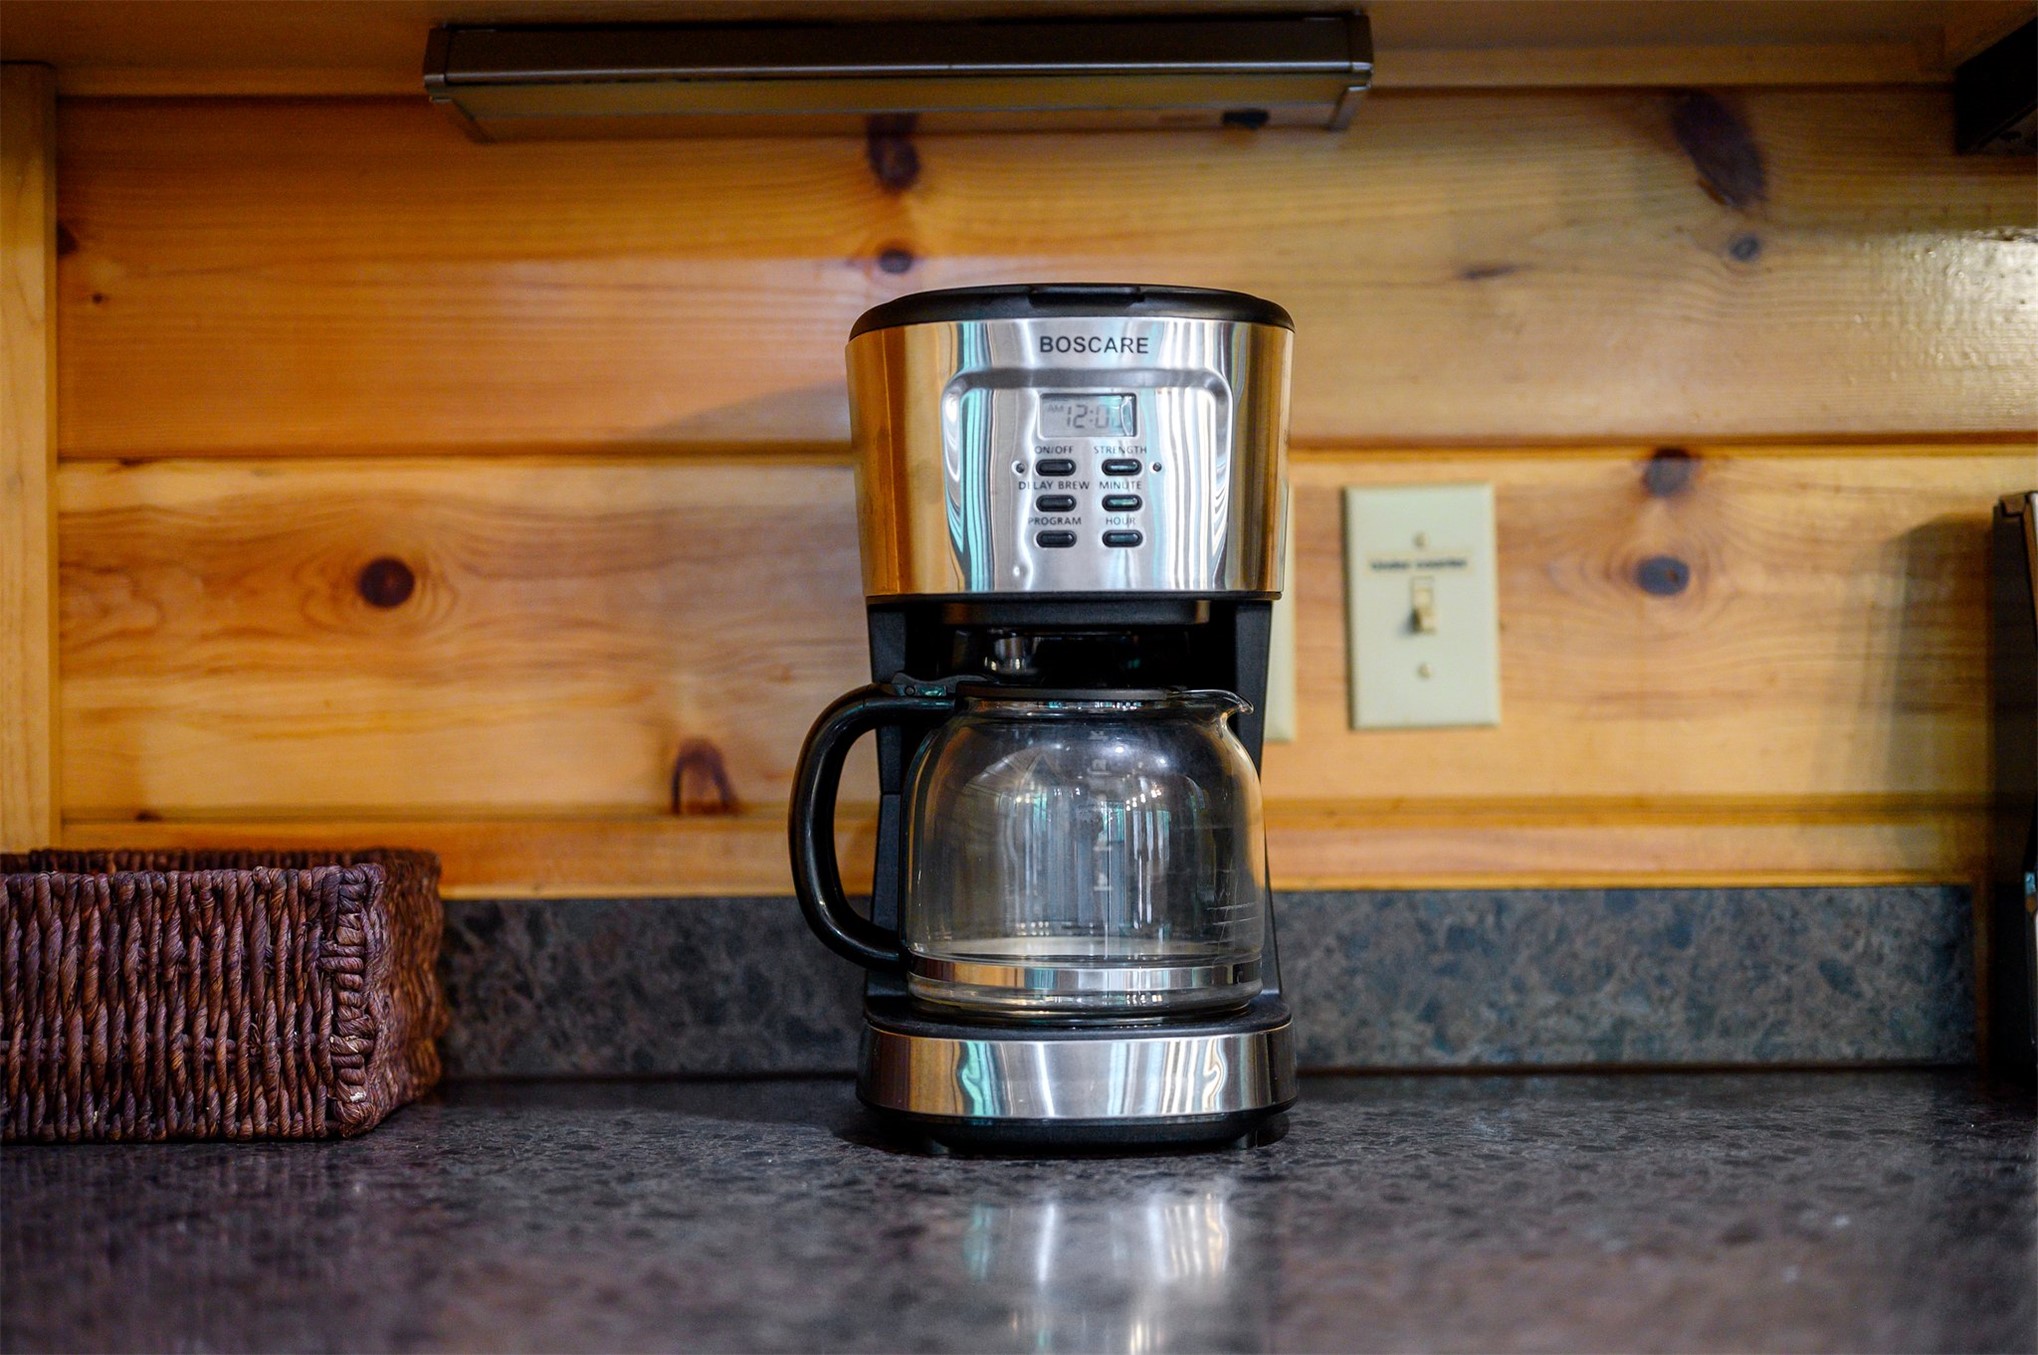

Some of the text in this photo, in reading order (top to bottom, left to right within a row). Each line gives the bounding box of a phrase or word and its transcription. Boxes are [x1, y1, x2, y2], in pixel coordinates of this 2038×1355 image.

[1040, 336, 1149, 353] BOSCARE
[1034, 445, 1074, 455] ON/OFF
[1093, 445, 1148, 455] STRENGTH
[1058, 480, 1090, 490] BREW
[1099, 480, 1142, 490] MINUTE
[1028, 516, 1082, 526] PROGRAM
[1105, 516, 1136, 526] HOUR
